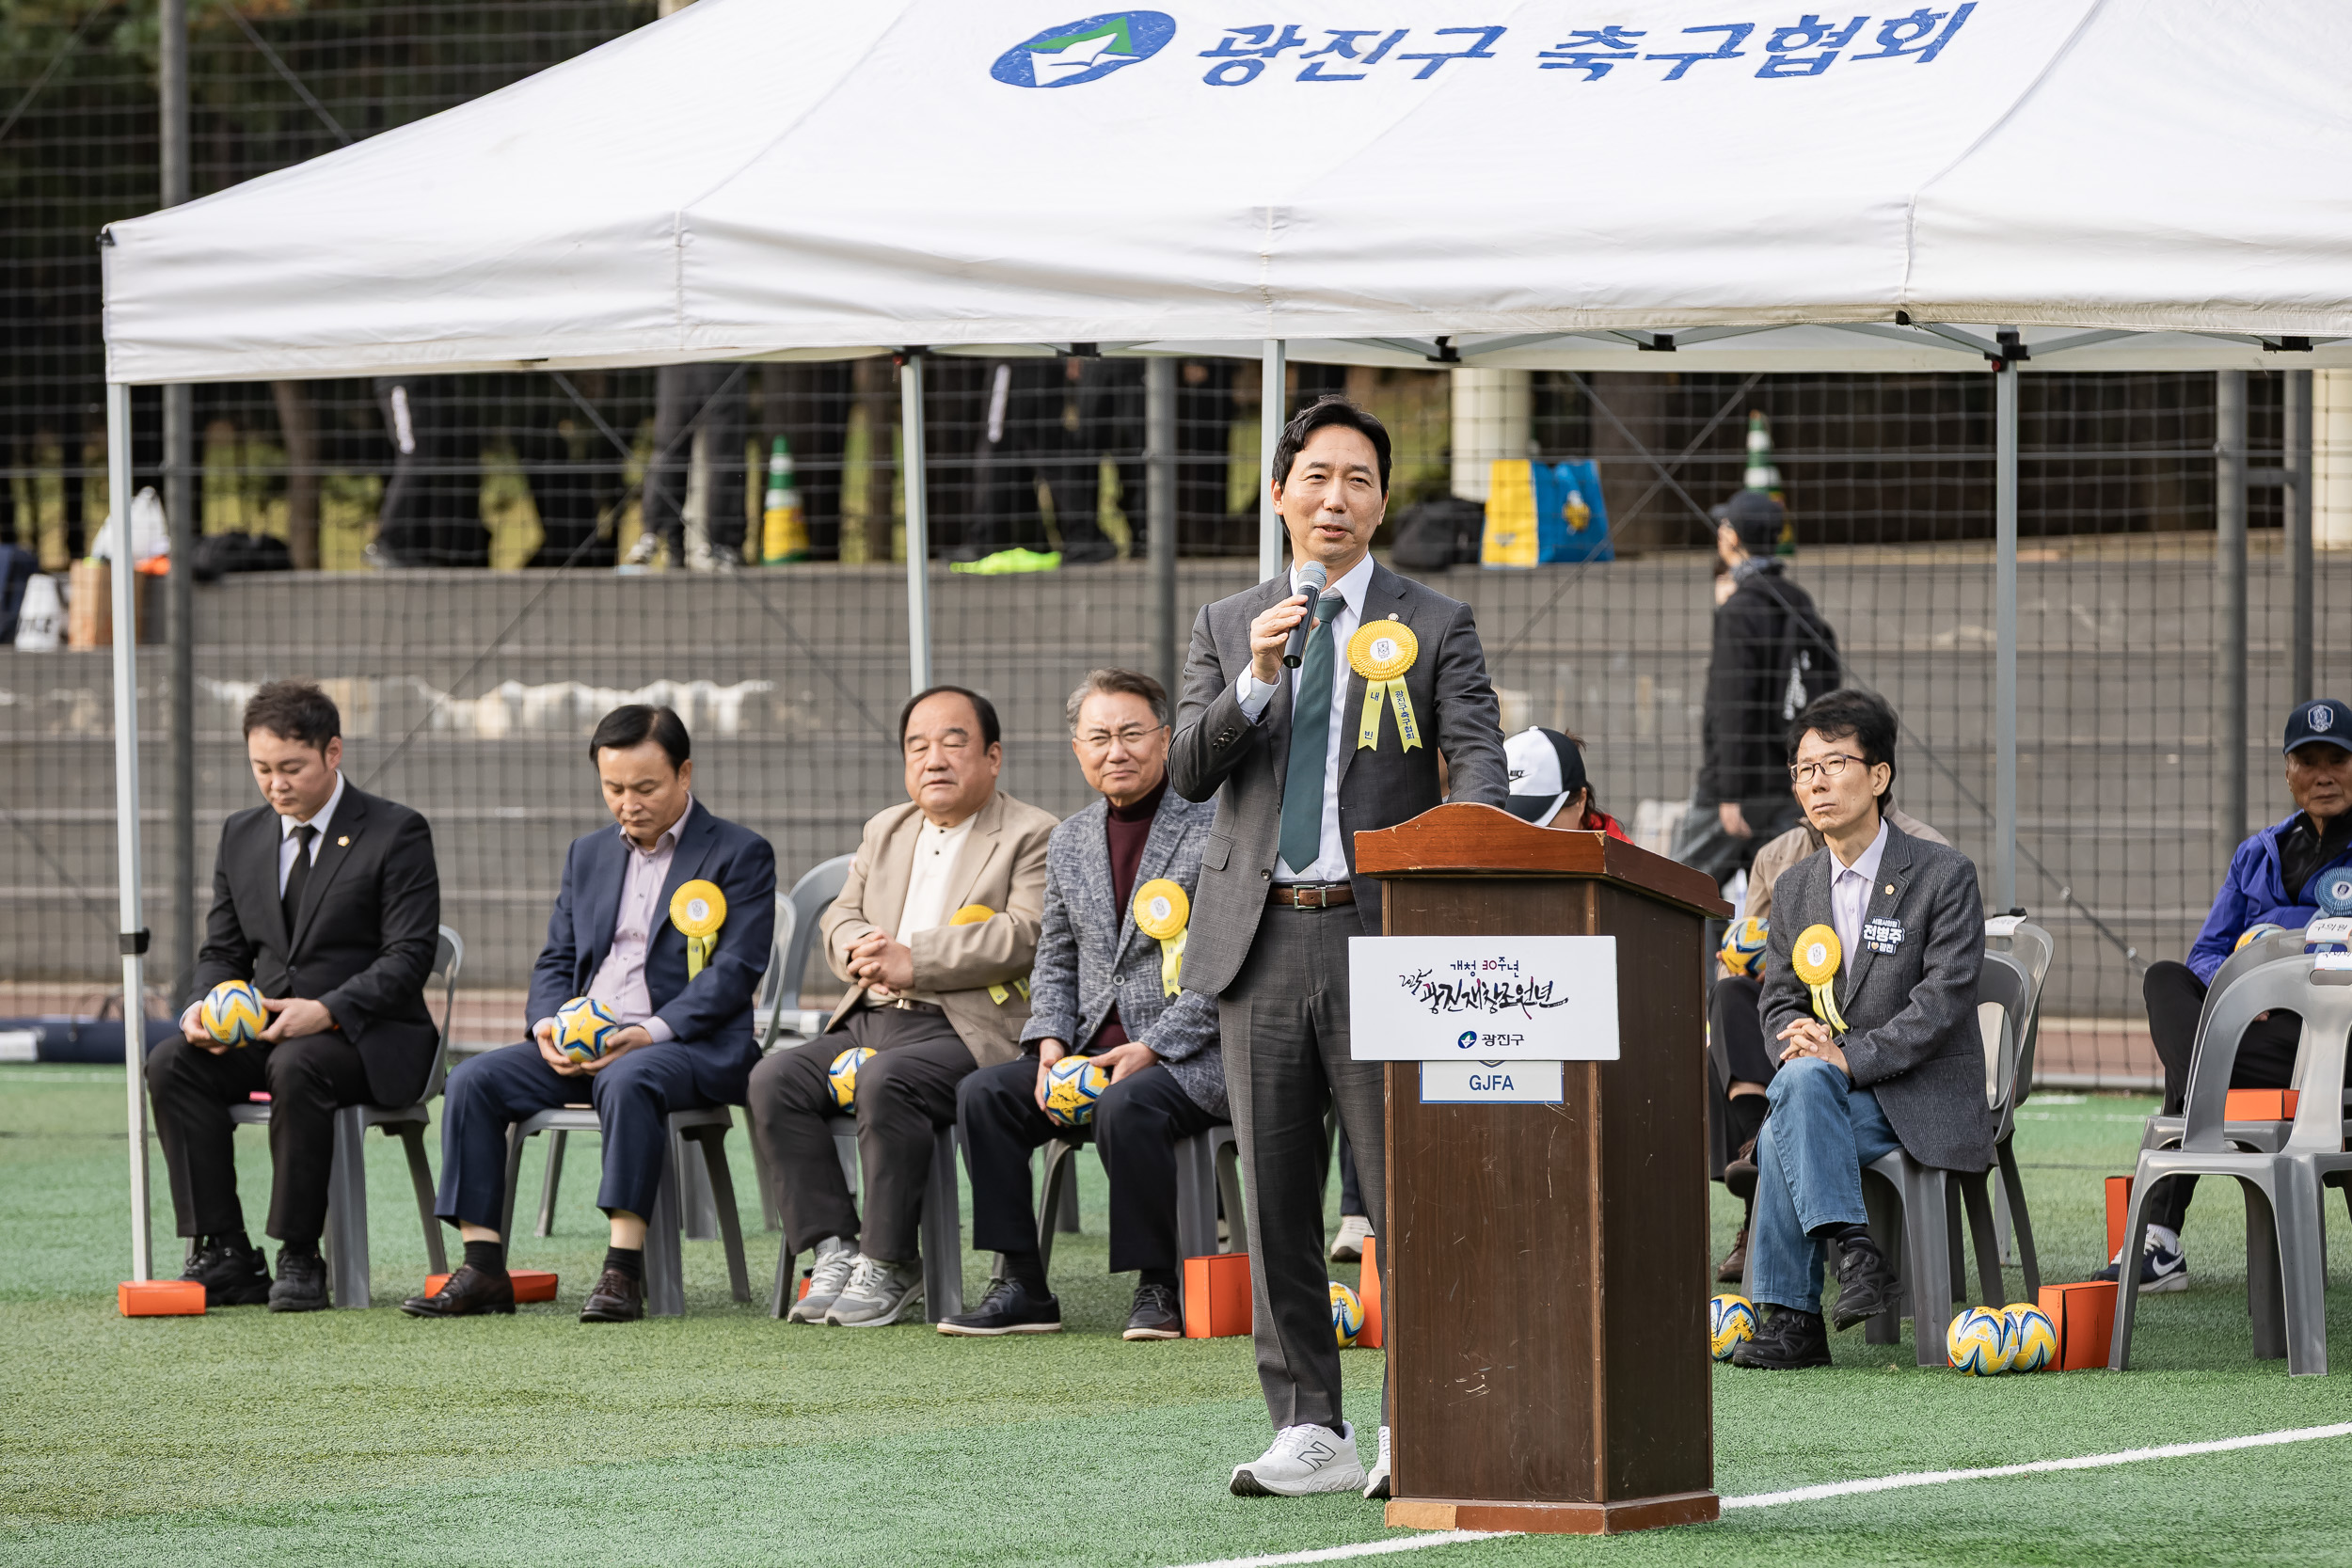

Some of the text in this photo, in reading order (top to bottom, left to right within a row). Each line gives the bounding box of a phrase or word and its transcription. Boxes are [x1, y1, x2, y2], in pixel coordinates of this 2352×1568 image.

[1199, 2, 1977, 86] 광진구 축구협회
[1395, 689, 1415, 740] 광진구축구협회
[1863, 924, 1903, 944] 전병주
[1450, 957, 1519, 978] 개청 30주년
[1482, 1034, 1525, 1046] 광진구
[1469, 1074, 1515, 1091] GJFA
